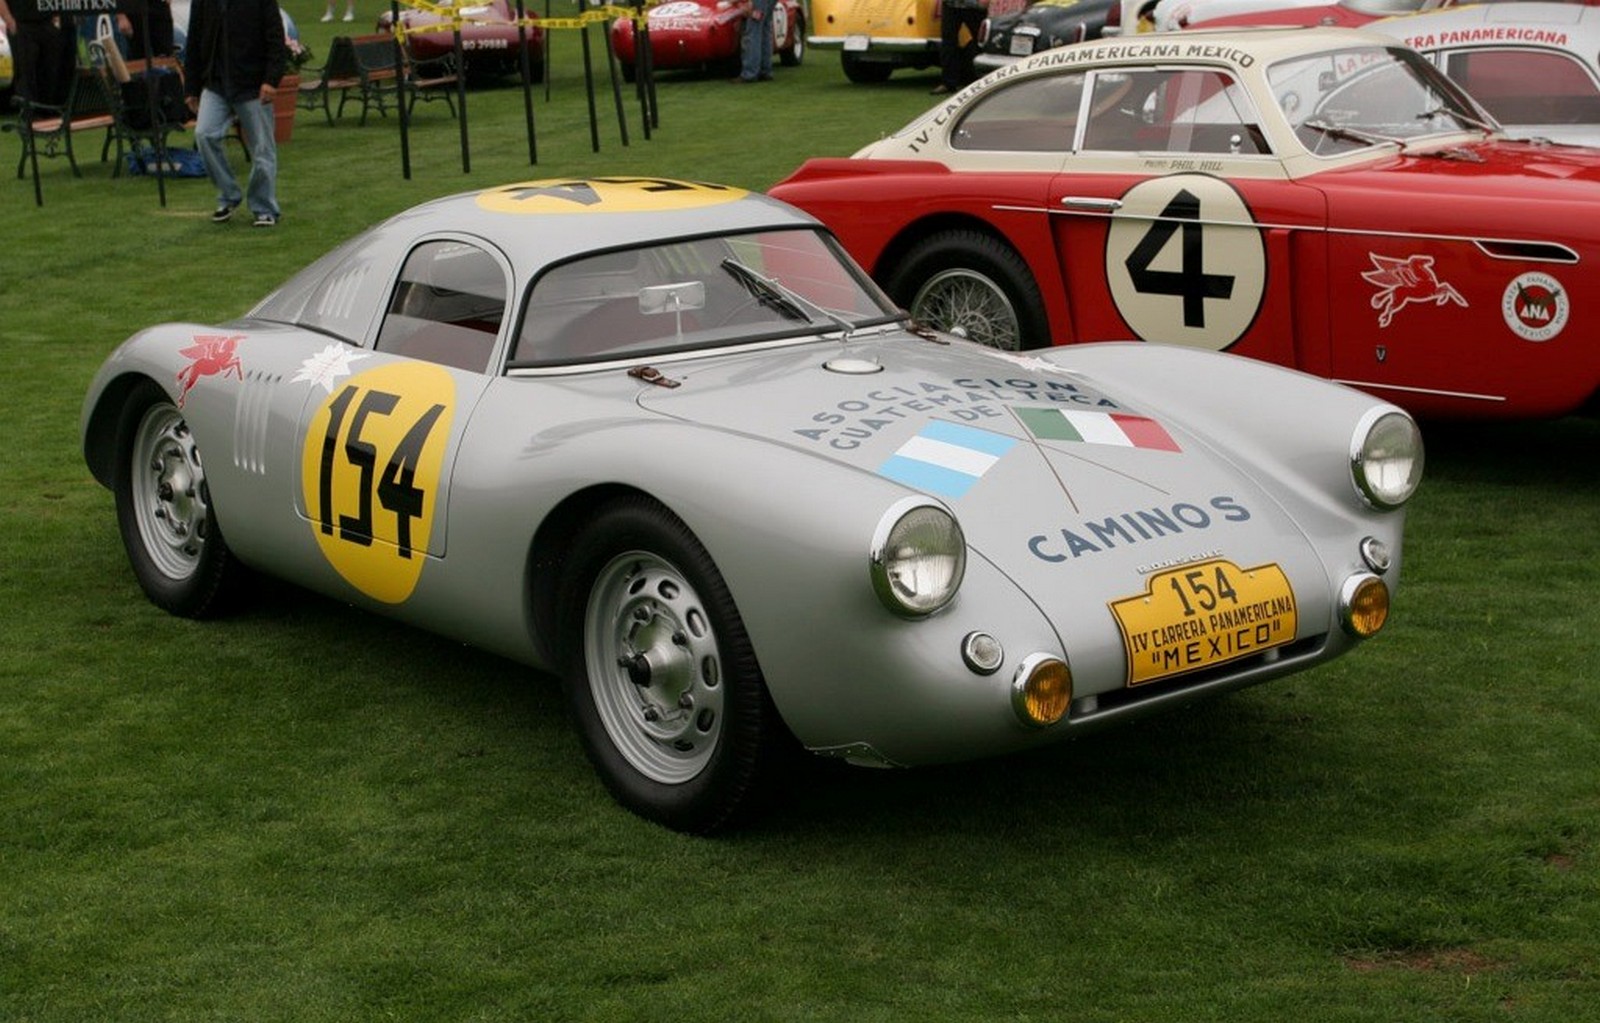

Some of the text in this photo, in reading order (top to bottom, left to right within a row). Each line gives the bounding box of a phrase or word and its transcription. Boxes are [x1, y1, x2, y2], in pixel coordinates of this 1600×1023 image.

[37, 0, 117, 11] EXHIBITION
[1440, 27, 1568, 46] PANAMERICANA
[934, 64, 1020, 126] CARRERA
[1027, 44, 1180, 69] PANAMERICANA
[1186, 45, 1255, 69] MEXICO
[1170, 160, 1196, 171] PHIL
[1199, 160, 1224, 172] HILL
[1124, 188, 1236, 329] 4
[794, 378, 1080, 442] ASOCIACION
[829, 386, 1119, 451] GUATEMALTECA
[950, 403, 1003, 421] DE
[319, 384, 447, 560] 154
[1028, 496, 1251, 563] CAMINOS
[1170, 566, 1238, 617] 154
[1131, 596, 1294, 654] IV CARRERA PANAMERICANA
[1152, 623, 1281, 670] "MEXICO"
